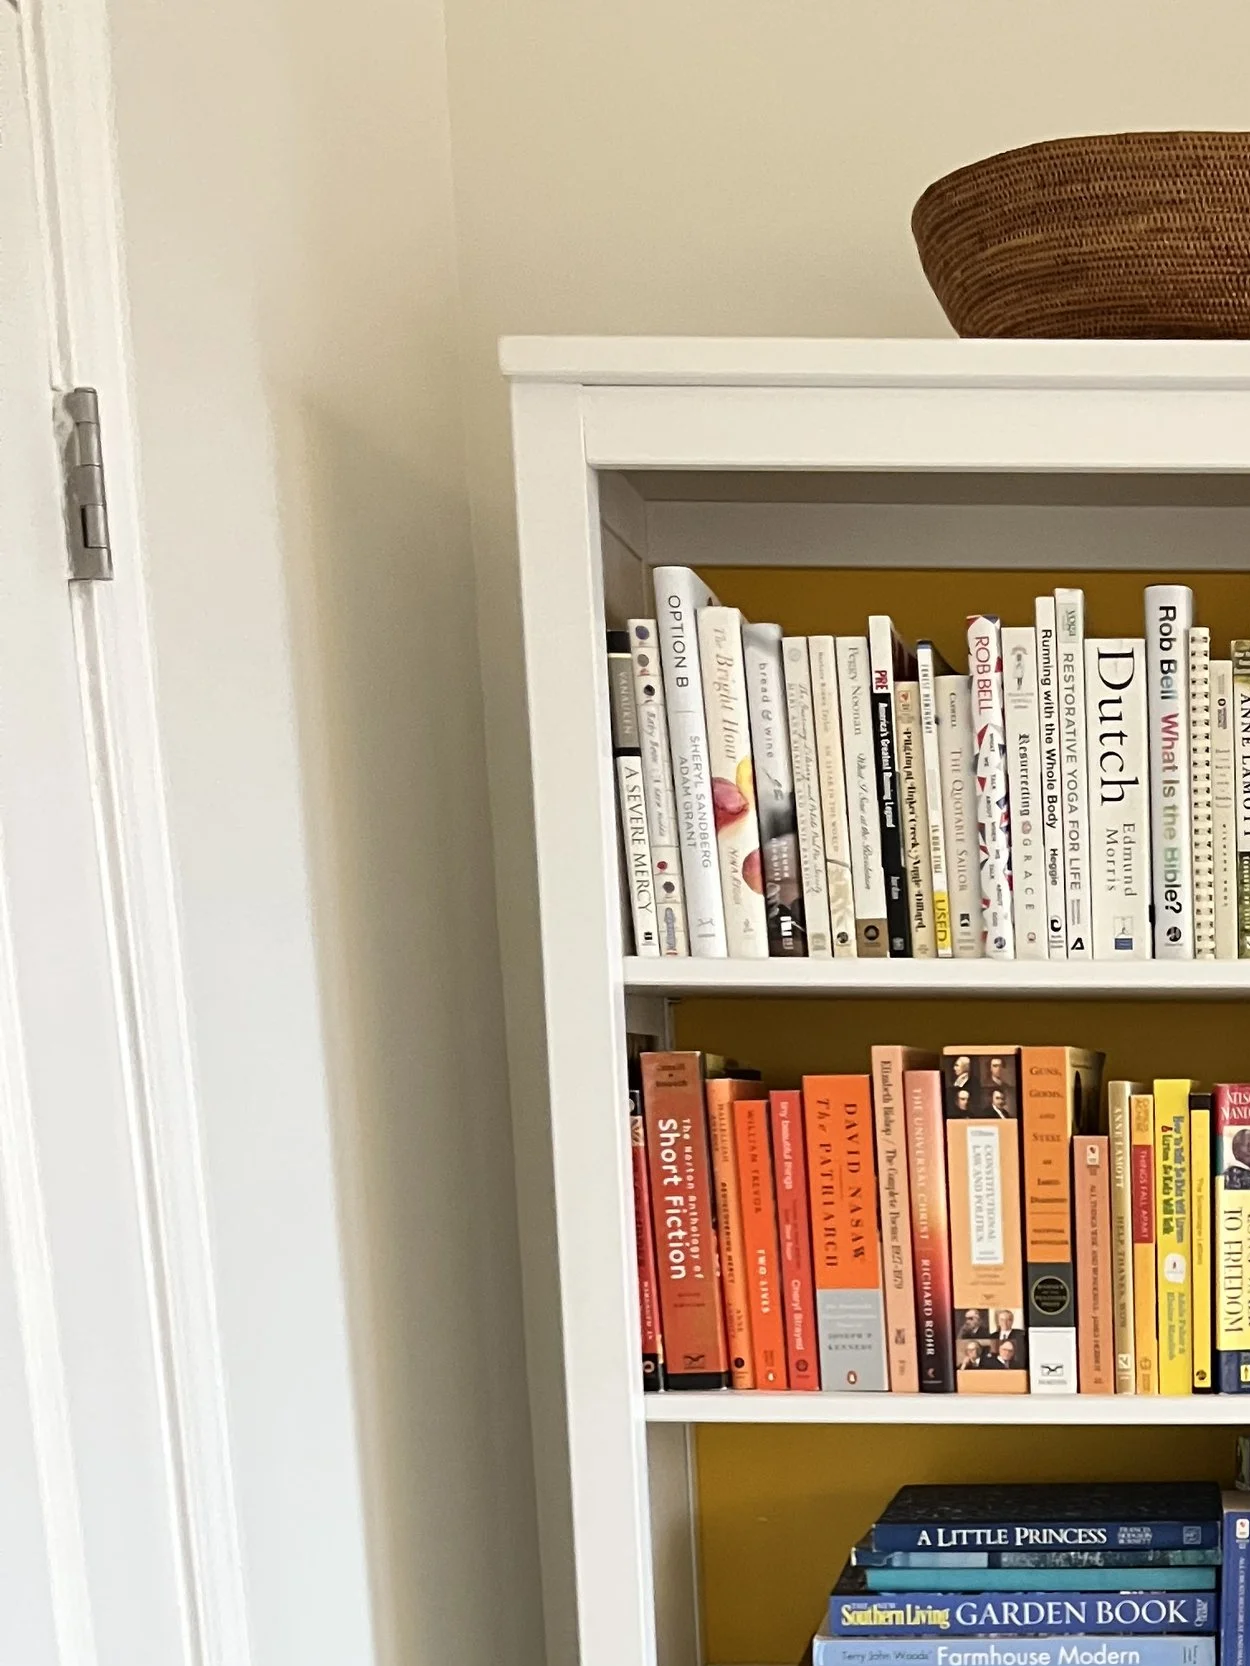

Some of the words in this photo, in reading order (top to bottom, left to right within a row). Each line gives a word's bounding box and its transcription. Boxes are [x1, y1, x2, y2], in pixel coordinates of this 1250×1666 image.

[667, 595, 687, 670] OPTION
[1159, 605, 1177, 652] Rob
[973, 636, 990, 675] ROB
[1041, 629, 1052, 686] Running
[676, 677, 689, 688] B
[976, 677, 992, 714] BELL
[1160, 659, 1177, 700] Bell
[1044, 693, 1053, 720] with
[1063, 653, 1076, 763] RESTORATIVE
[1097, 647, 1139, 806] Dutch
[1045, 724, 1053, 744] the
[1161, 713, 1179, 773] What
[624, 767, 639, 780] A
[1045, 748, 1056, 789] Whole
[1047, 793, 1057, 828] Body
[1065, 769, 1078, 814] YOGA
[626, 785, 647, 846] SEVERE
[1068, 820, 1080, 853] FOR
[1162, 806, 1181, 839] the
[633, 850, 653, 913] MERCY
[1105, 829, 1116, 891] Morris
[1123, 822, 1137, 896] Edmund
[1164, 848, 1182, 914] Bible?
[934, 899, 947, 942] USED
[658, 1118, 682, 1186] Short
[845, 1103, 860, 1173] DAVID
[820, 1142, 838, 1267] PATRIARCH
[850, 1187, 864, 1259] NASAW
[1223, 1208, 1242, 1230] TO
[664, 1196, 686, 1279] Fiction
[917, 1530, 932, 1547] A
[937, 1527, 1009, 1547] LITTLE
[1015, 1527, 1106, 1545] PRINCESS
[841, 1605, 905, 1626] Southern
[906, 1605, 950, 1628] Living
[955, 1601, 1087, 1625] GARDEN
[1096, 1600, 1188, 1624] BOOK
[937, 1646, 1052, 1666] Farmhouse
[1058, 1647, 1141, 1665] Modern
